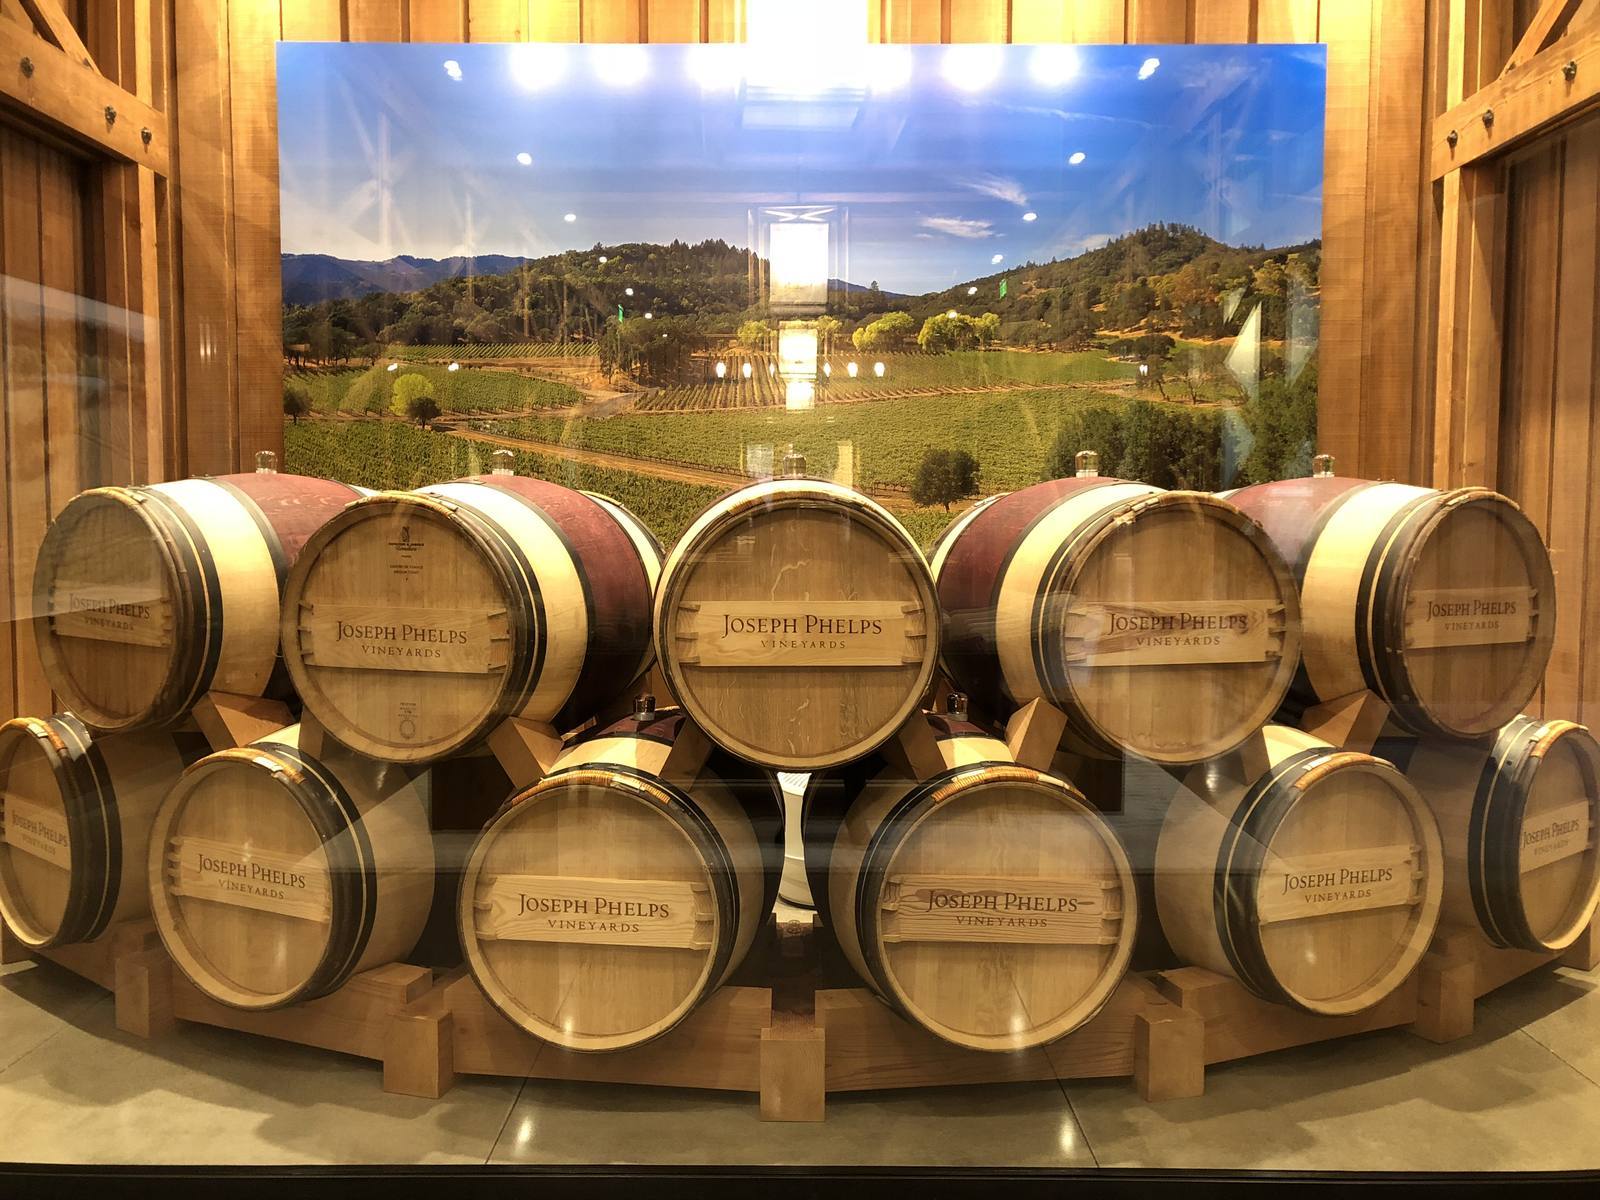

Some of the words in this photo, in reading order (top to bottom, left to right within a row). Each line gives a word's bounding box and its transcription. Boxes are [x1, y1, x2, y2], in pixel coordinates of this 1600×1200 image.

[108, 599, 151, 619] PHELPS
[1426, 601, 1470, 622] JOSEPH
[1473, 600, 1517, 616] PHELPS
[336, 621, 396, 642] JOSEPH
[402, 625, 468, 644] PHELPS
[721, 614, 797, 639] JOSEPH
[805, 614, 882, 635] PHELPS
[1107, 613, 1174, 636] JOSEPH
[1180, 612, 1248, 630] PHELPS
[1444, 621, 1500, 631] VINEYARDS
[361, 645, 441, 658] VINEYARDS
[760, 640, 846, 649] VINEYARDS
[1136, 636, 1221, 647] VINEYARDS
[198, 853, 247, 878] JOSEPH
[251, 862, 306, 889] PHELPS
[1282, 873, 1336, 896] JOSEPH
[1339, 867, 1393, 885] PHELPS
[218, 878, 285, 900] VINEYARDS
[1304, 888, 1373, 904] VINEYARDS
[518, 893, 588, 916] JOSEPH
[594, 897, 670, 918] PHELPS
[926, 890, 998, 912] JOSEPH
[1004, 892, 1079, 912] PHELPS
[547, 919, 640, 933] VINEYARDS
[955, 915, 1048, 928] VINEYARDS
